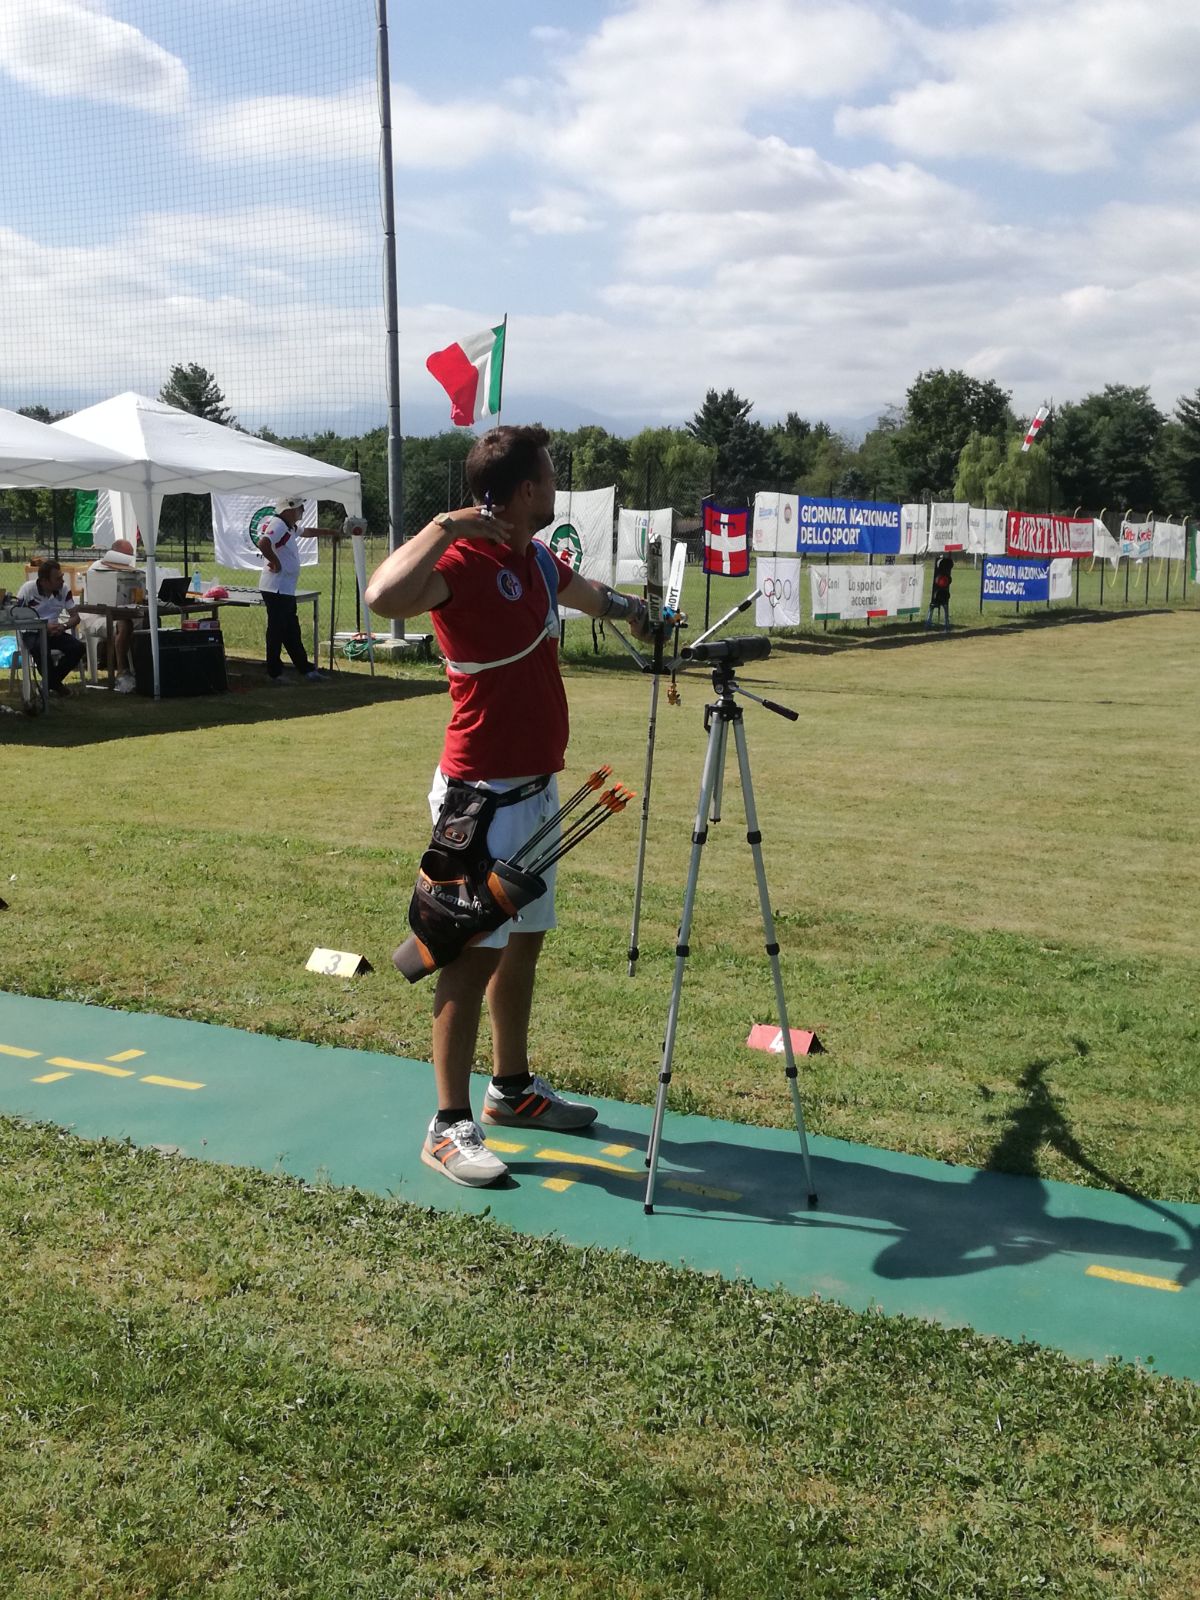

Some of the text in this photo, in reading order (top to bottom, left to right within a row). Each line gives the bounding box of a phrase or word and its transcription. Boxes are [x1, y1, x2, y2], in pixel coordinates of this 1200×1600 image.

[801, 505, 846, 525] GIORNATA
[849, 507, 899, 528] NAZIONALE
[801, 527, 860, 545] DELLO SPORT
[1010, 517, 1070, 553] LAURETANA
[986, 563, 1016, 579] GIORNATA
[984, 579, 1005, 594] DELLO
[325, 954, 342, 973] 3
